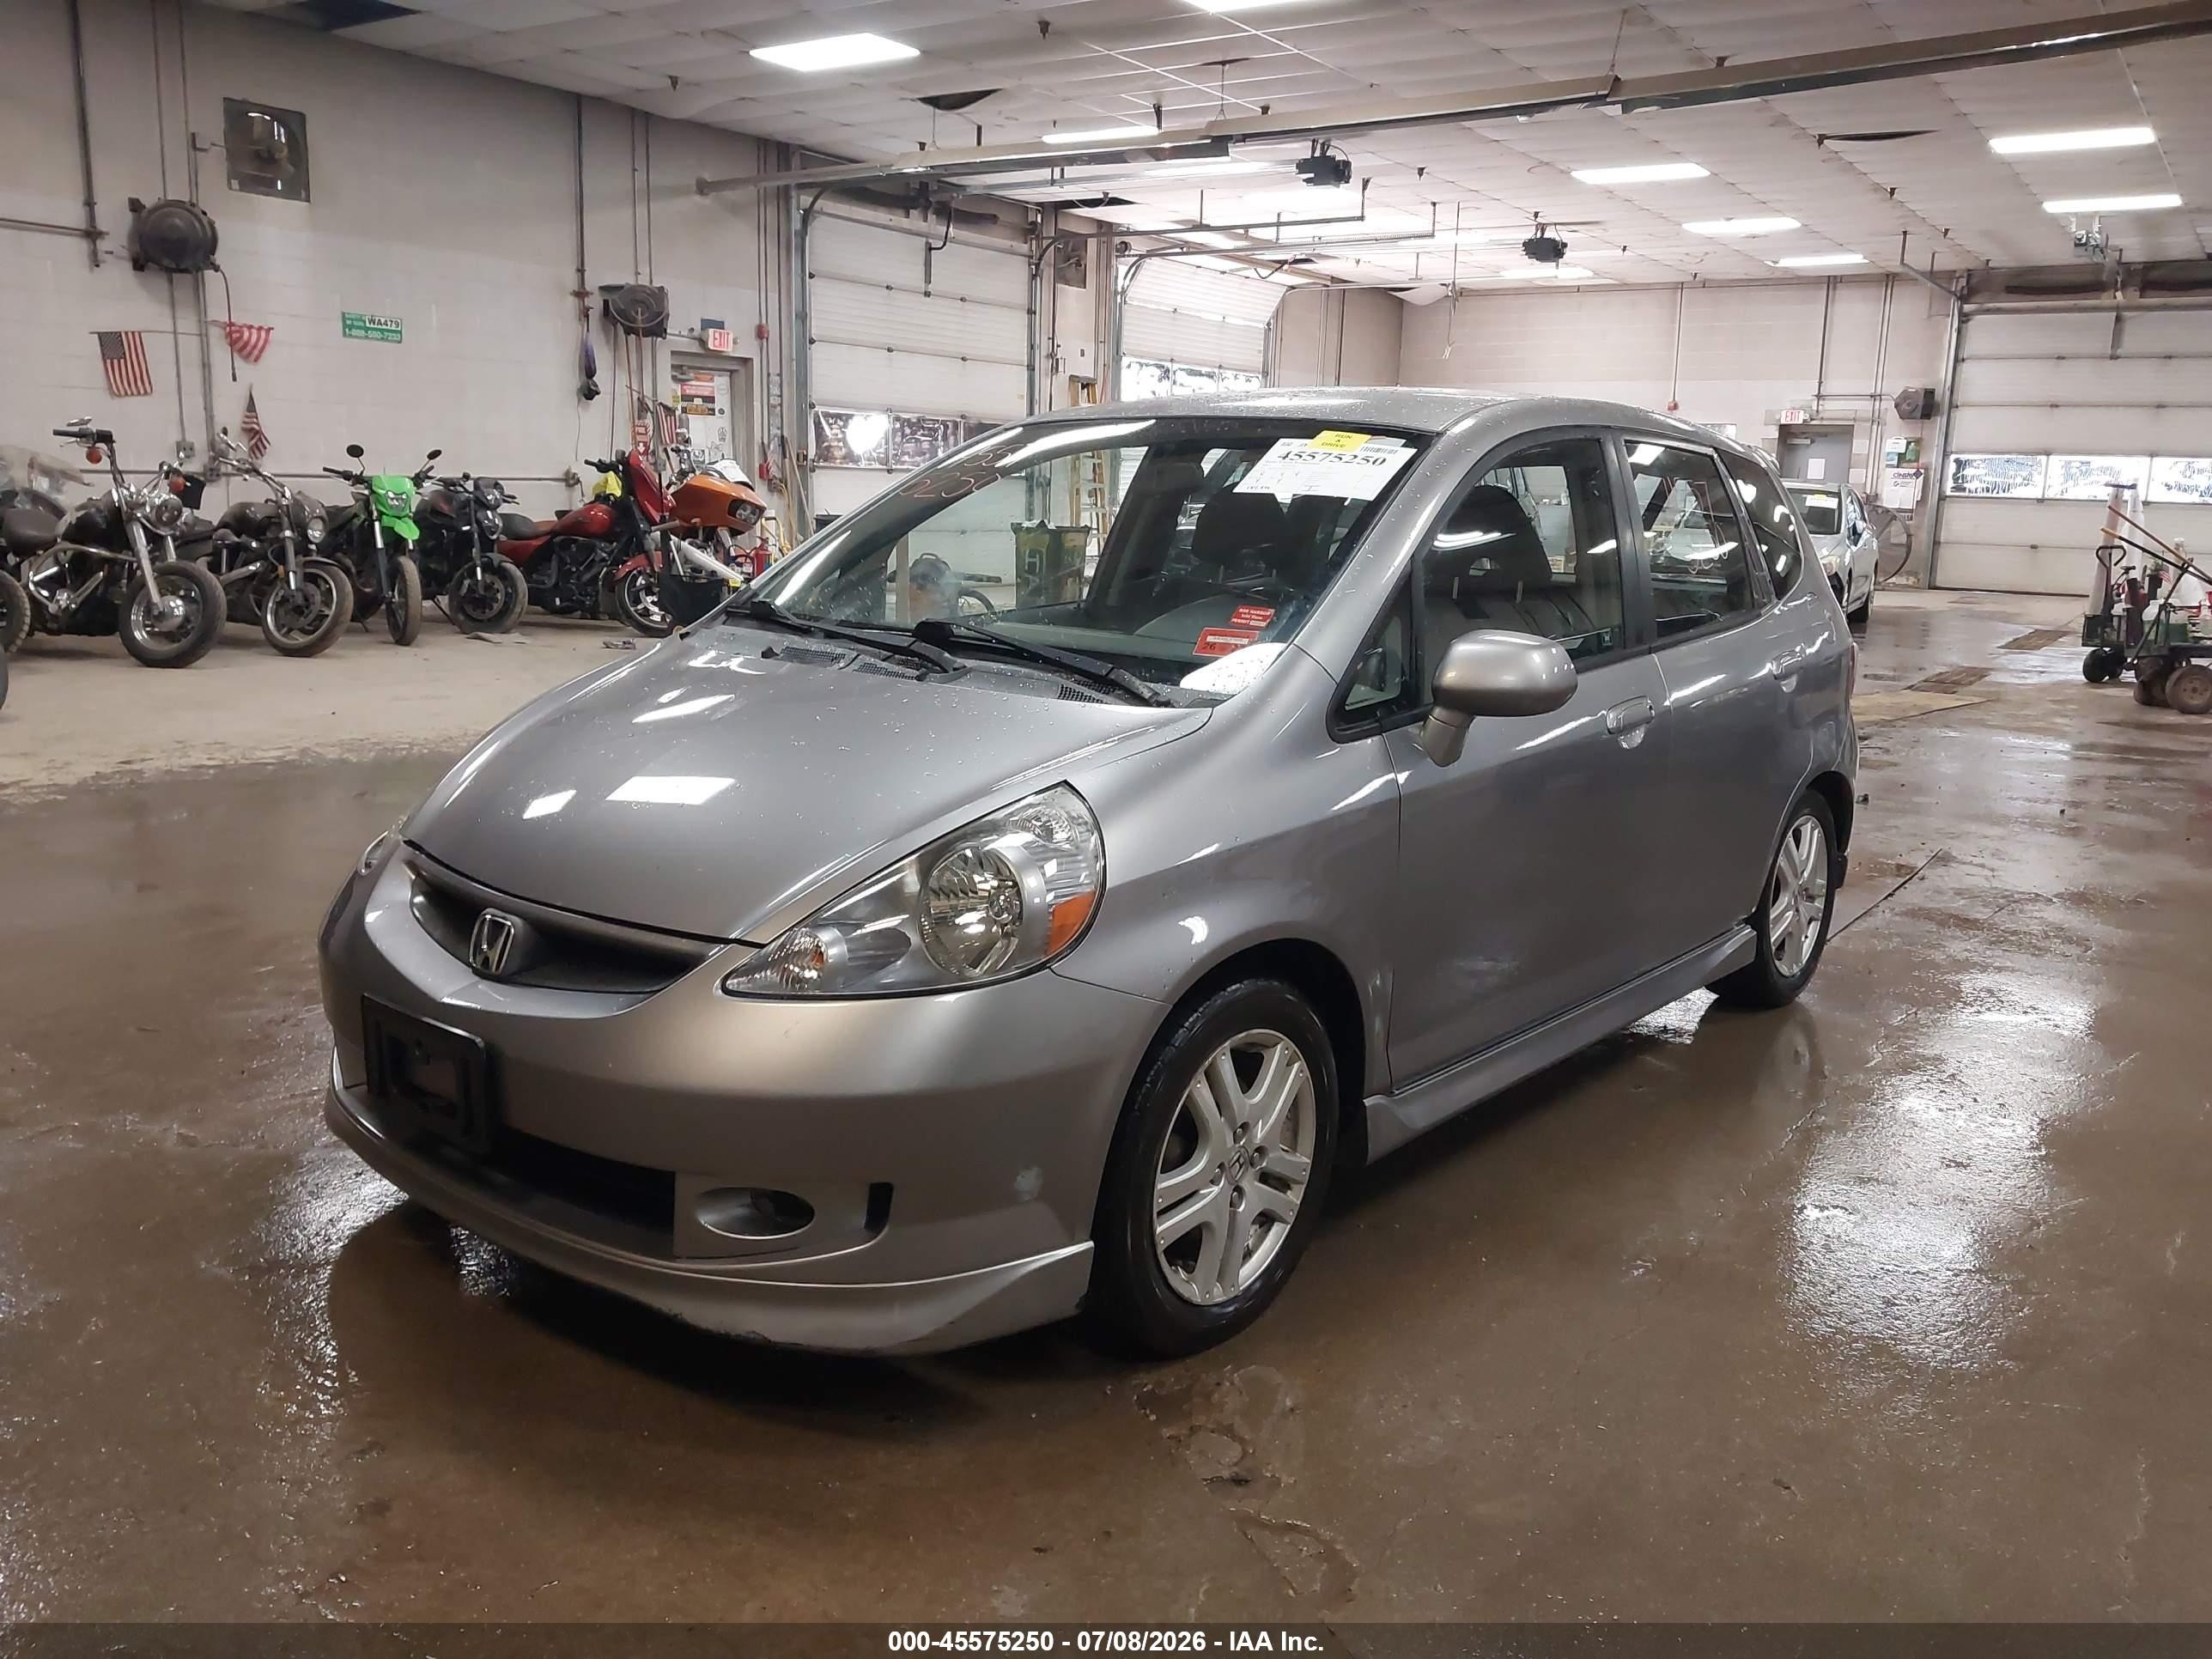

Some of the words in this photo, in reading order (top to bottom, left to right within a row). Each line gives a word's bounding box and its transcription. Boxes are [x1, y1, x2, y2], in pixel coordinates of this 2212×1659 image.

[368, 317, 400, 328] WA479
[713, 331, 730, 349] EXIT
[1785, 411, 1801, 422] EXIT
[1278, 450, 1388, 466] 45575250
